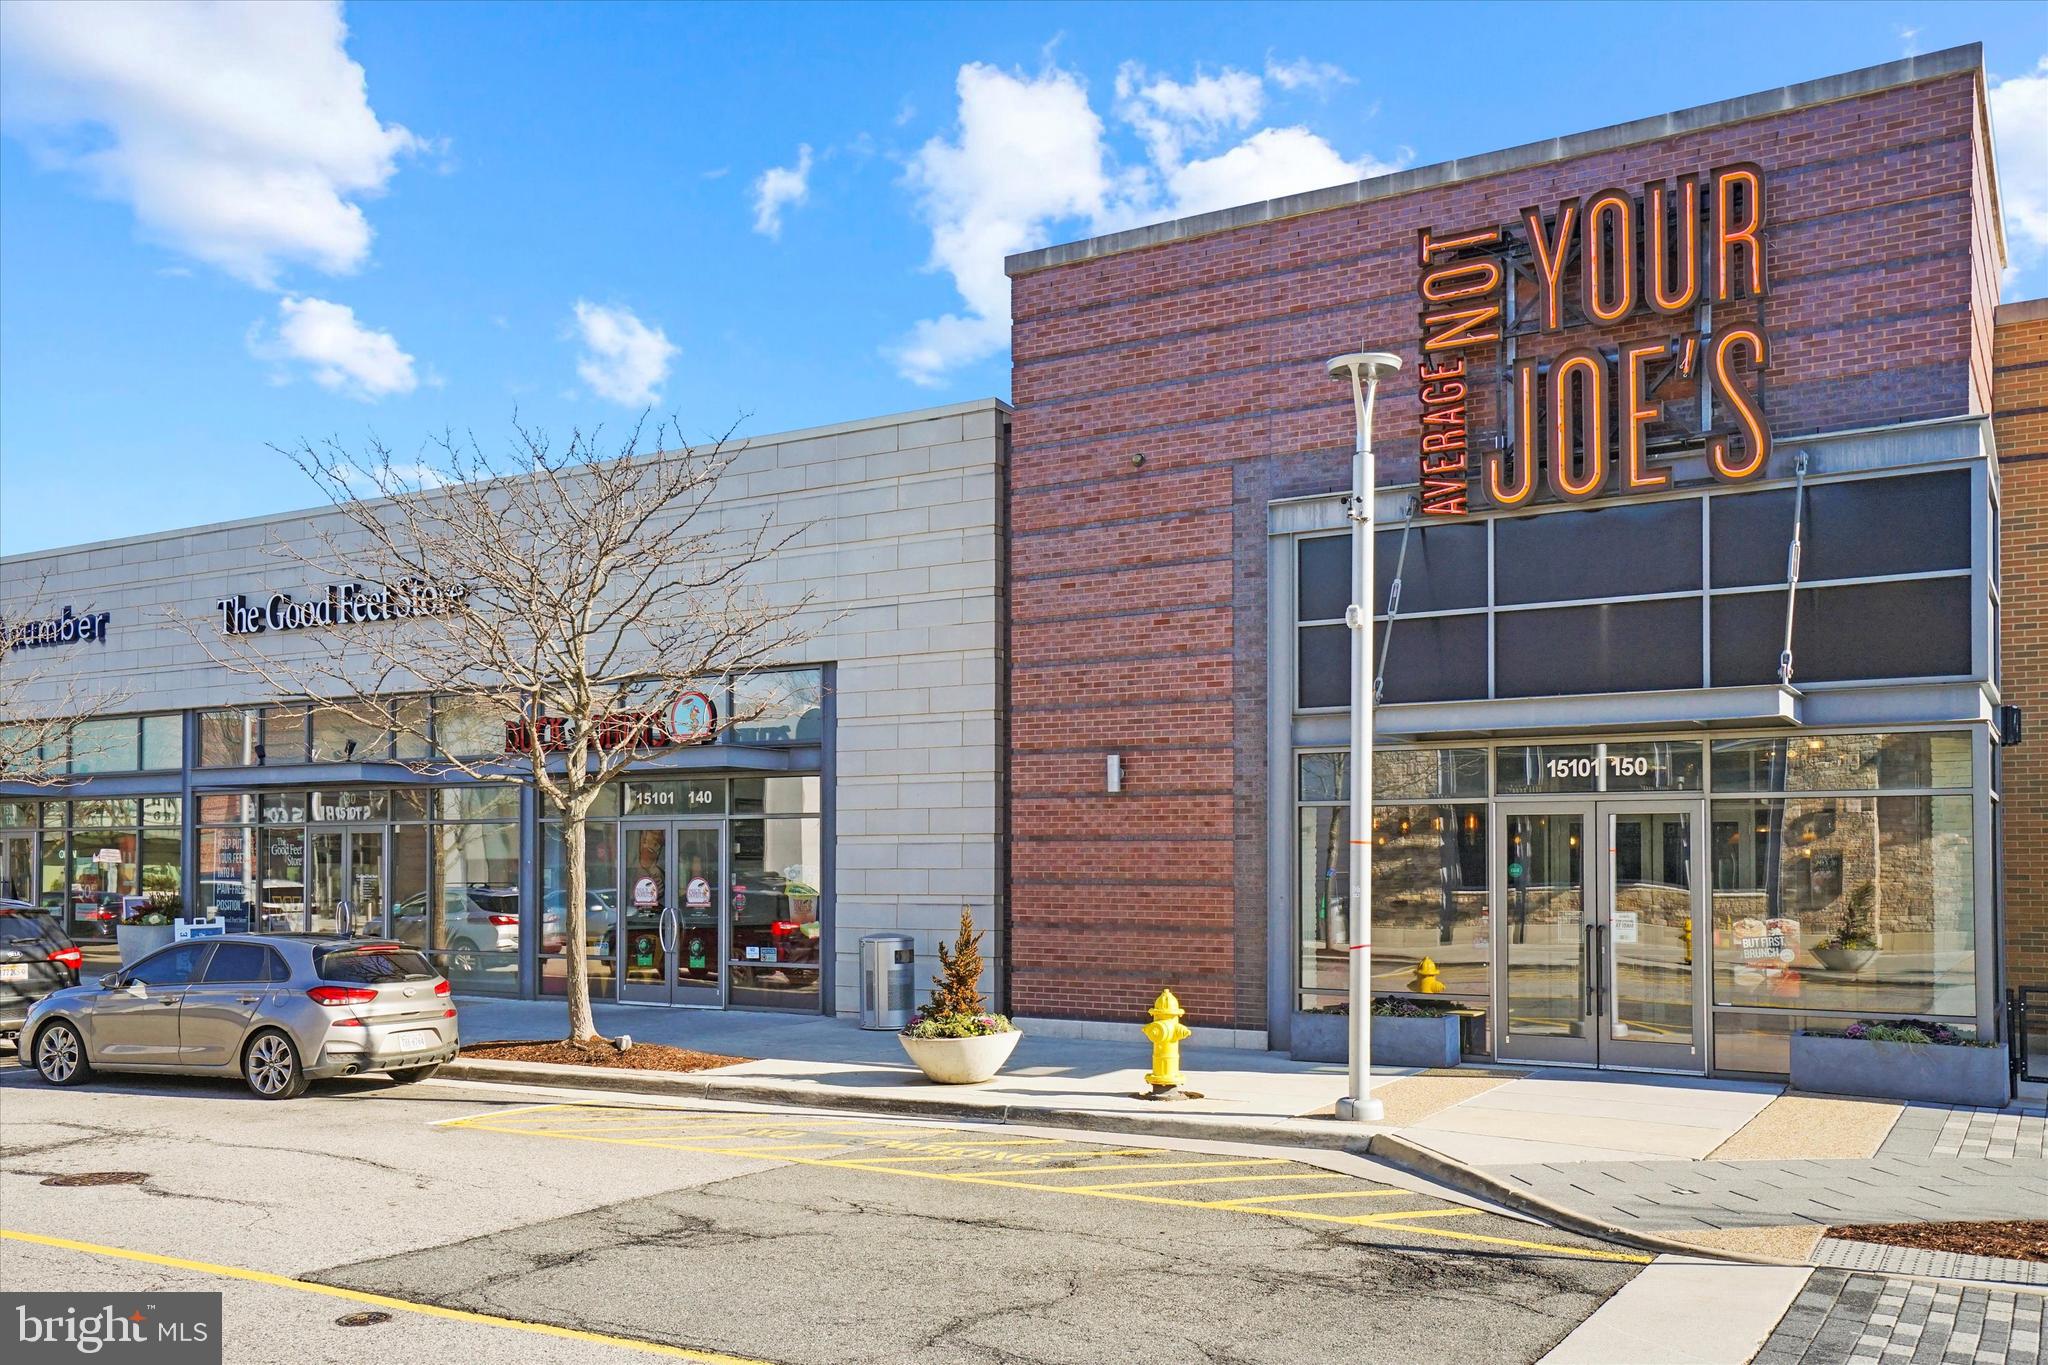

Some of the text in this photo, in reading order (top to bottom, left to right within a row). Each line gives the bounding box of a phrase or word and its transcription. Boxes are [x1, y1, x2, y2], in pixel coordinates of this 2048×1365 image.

[1519, 161, 1770, 334] YOUR
[1418, 226, 1503, 351] NOT
[1481, 320, 1773, 511] JOE'S
[1418, 357, 1469, 516] AVERAGE
[217, 594, 260, 635] The
[265, 593, 331, 631] Good
[337, 584, 393, 624] Feet
[1547, 757, 1648, 778] 15101 150
[637, 790, 712, 805] 15101 140
[271, 844, 289, 856] Good
[1743, 937, 1759, 948] BUT
[1744, 947, 1780, 959] BRUNCH
